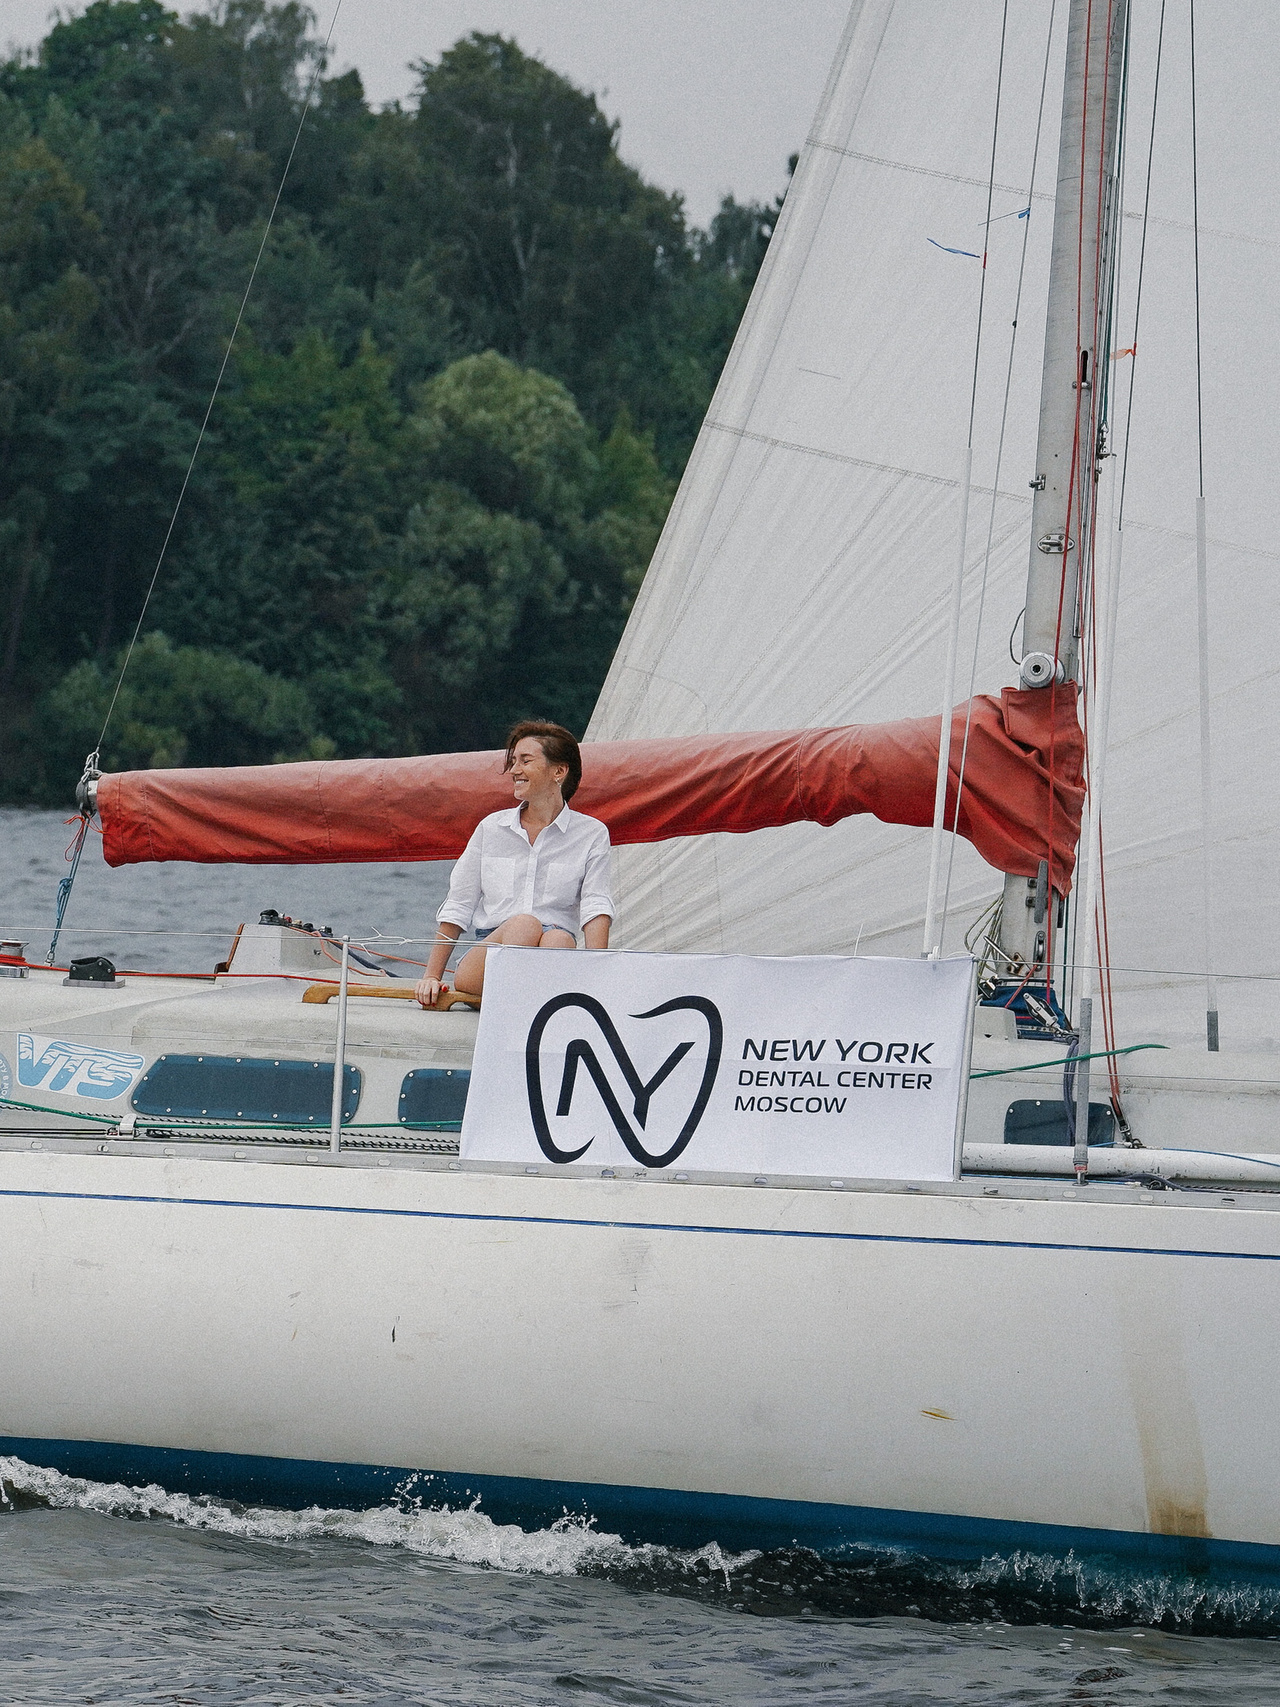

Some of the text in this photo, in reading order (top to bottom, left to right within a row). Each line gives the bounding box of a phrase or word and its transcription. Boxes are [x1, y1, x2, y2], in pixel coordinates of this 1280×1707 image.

[741, 1038, 935, 1065] NEW YORK
[738, 1069, 933, 1090] DENTAL CENTER
[734, 1095, 848, 1114] MOSCOW
